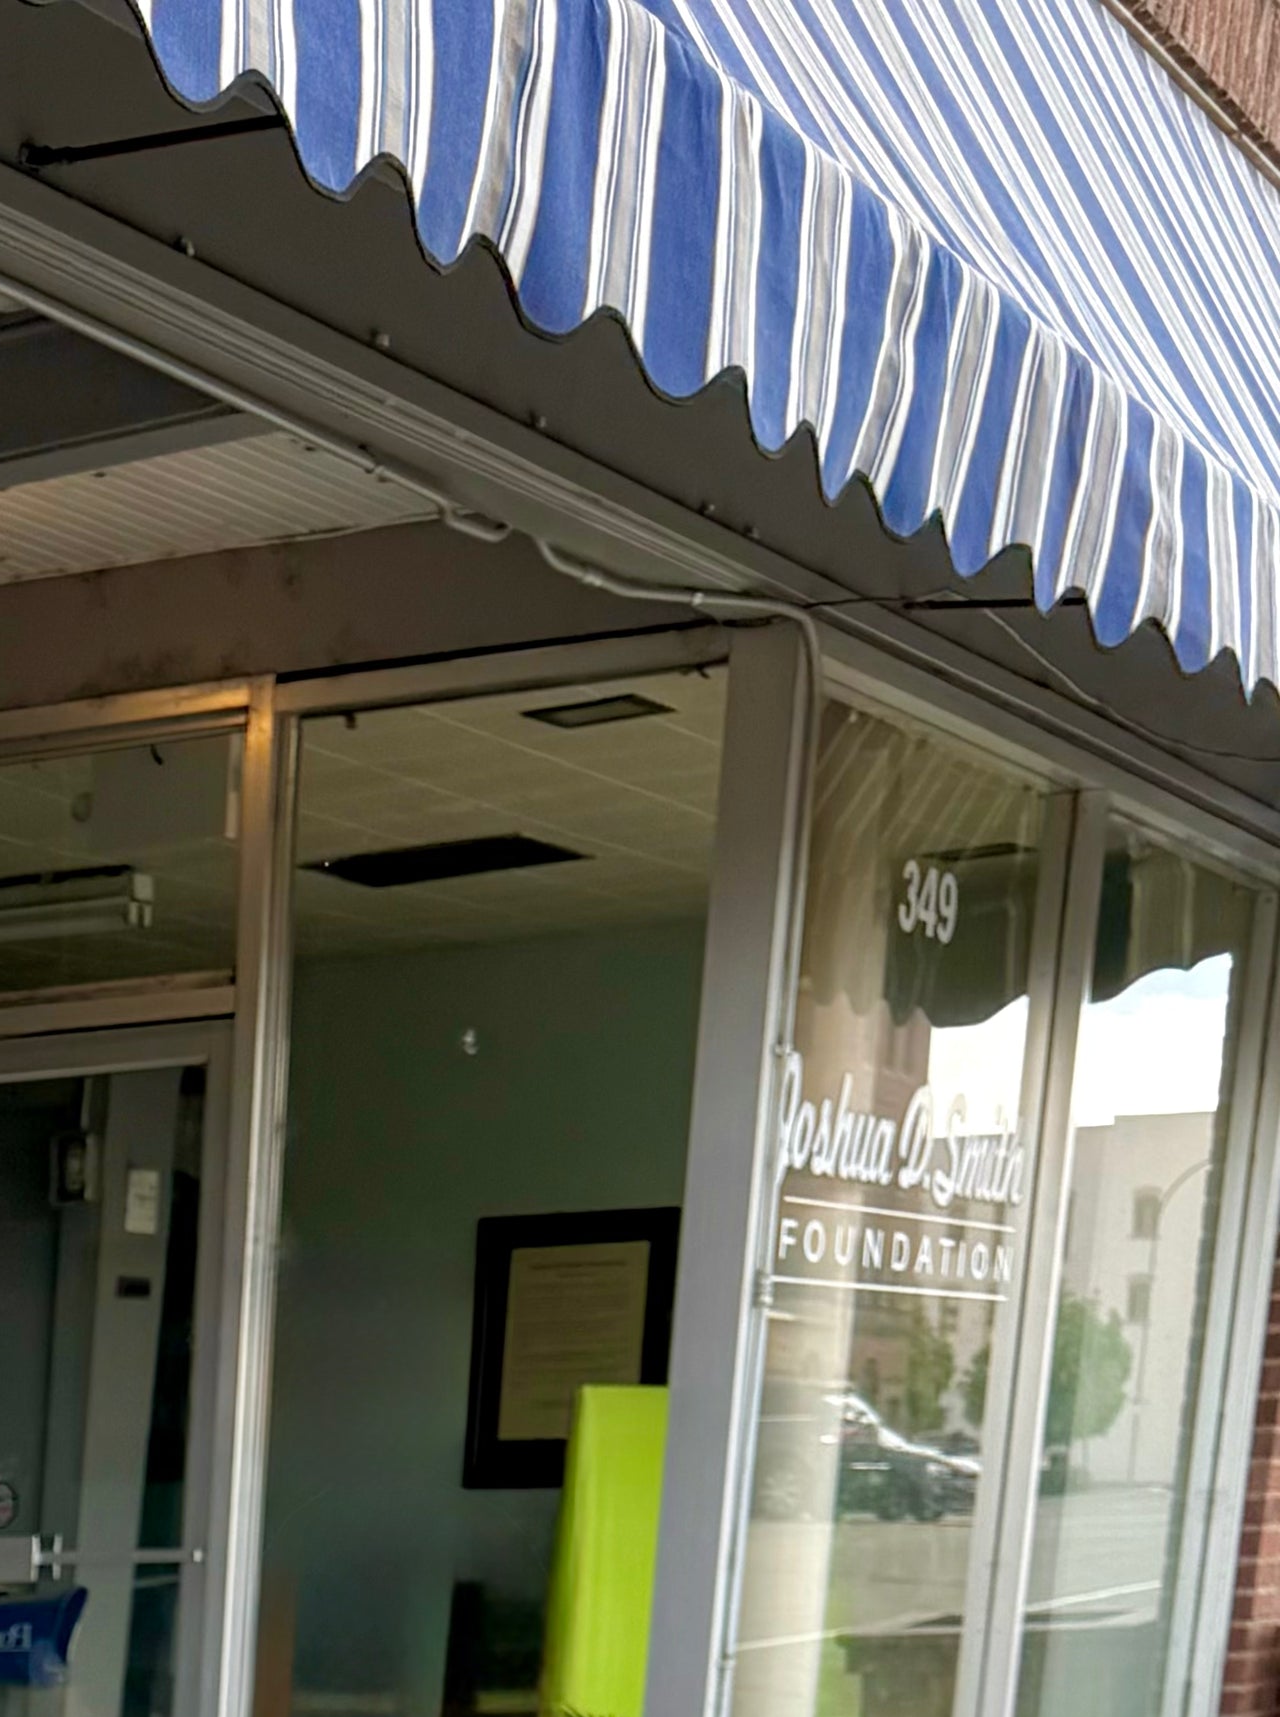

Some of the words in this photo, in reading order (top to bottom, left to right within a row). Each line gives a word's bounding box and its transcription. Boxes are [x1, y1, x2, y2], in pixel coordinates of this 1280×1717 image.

[898, 858, 959, 946] 349
[778, 1049, 896, 1187] Joshua
[777, 1216, 1016, 1283] FOUNDATION
